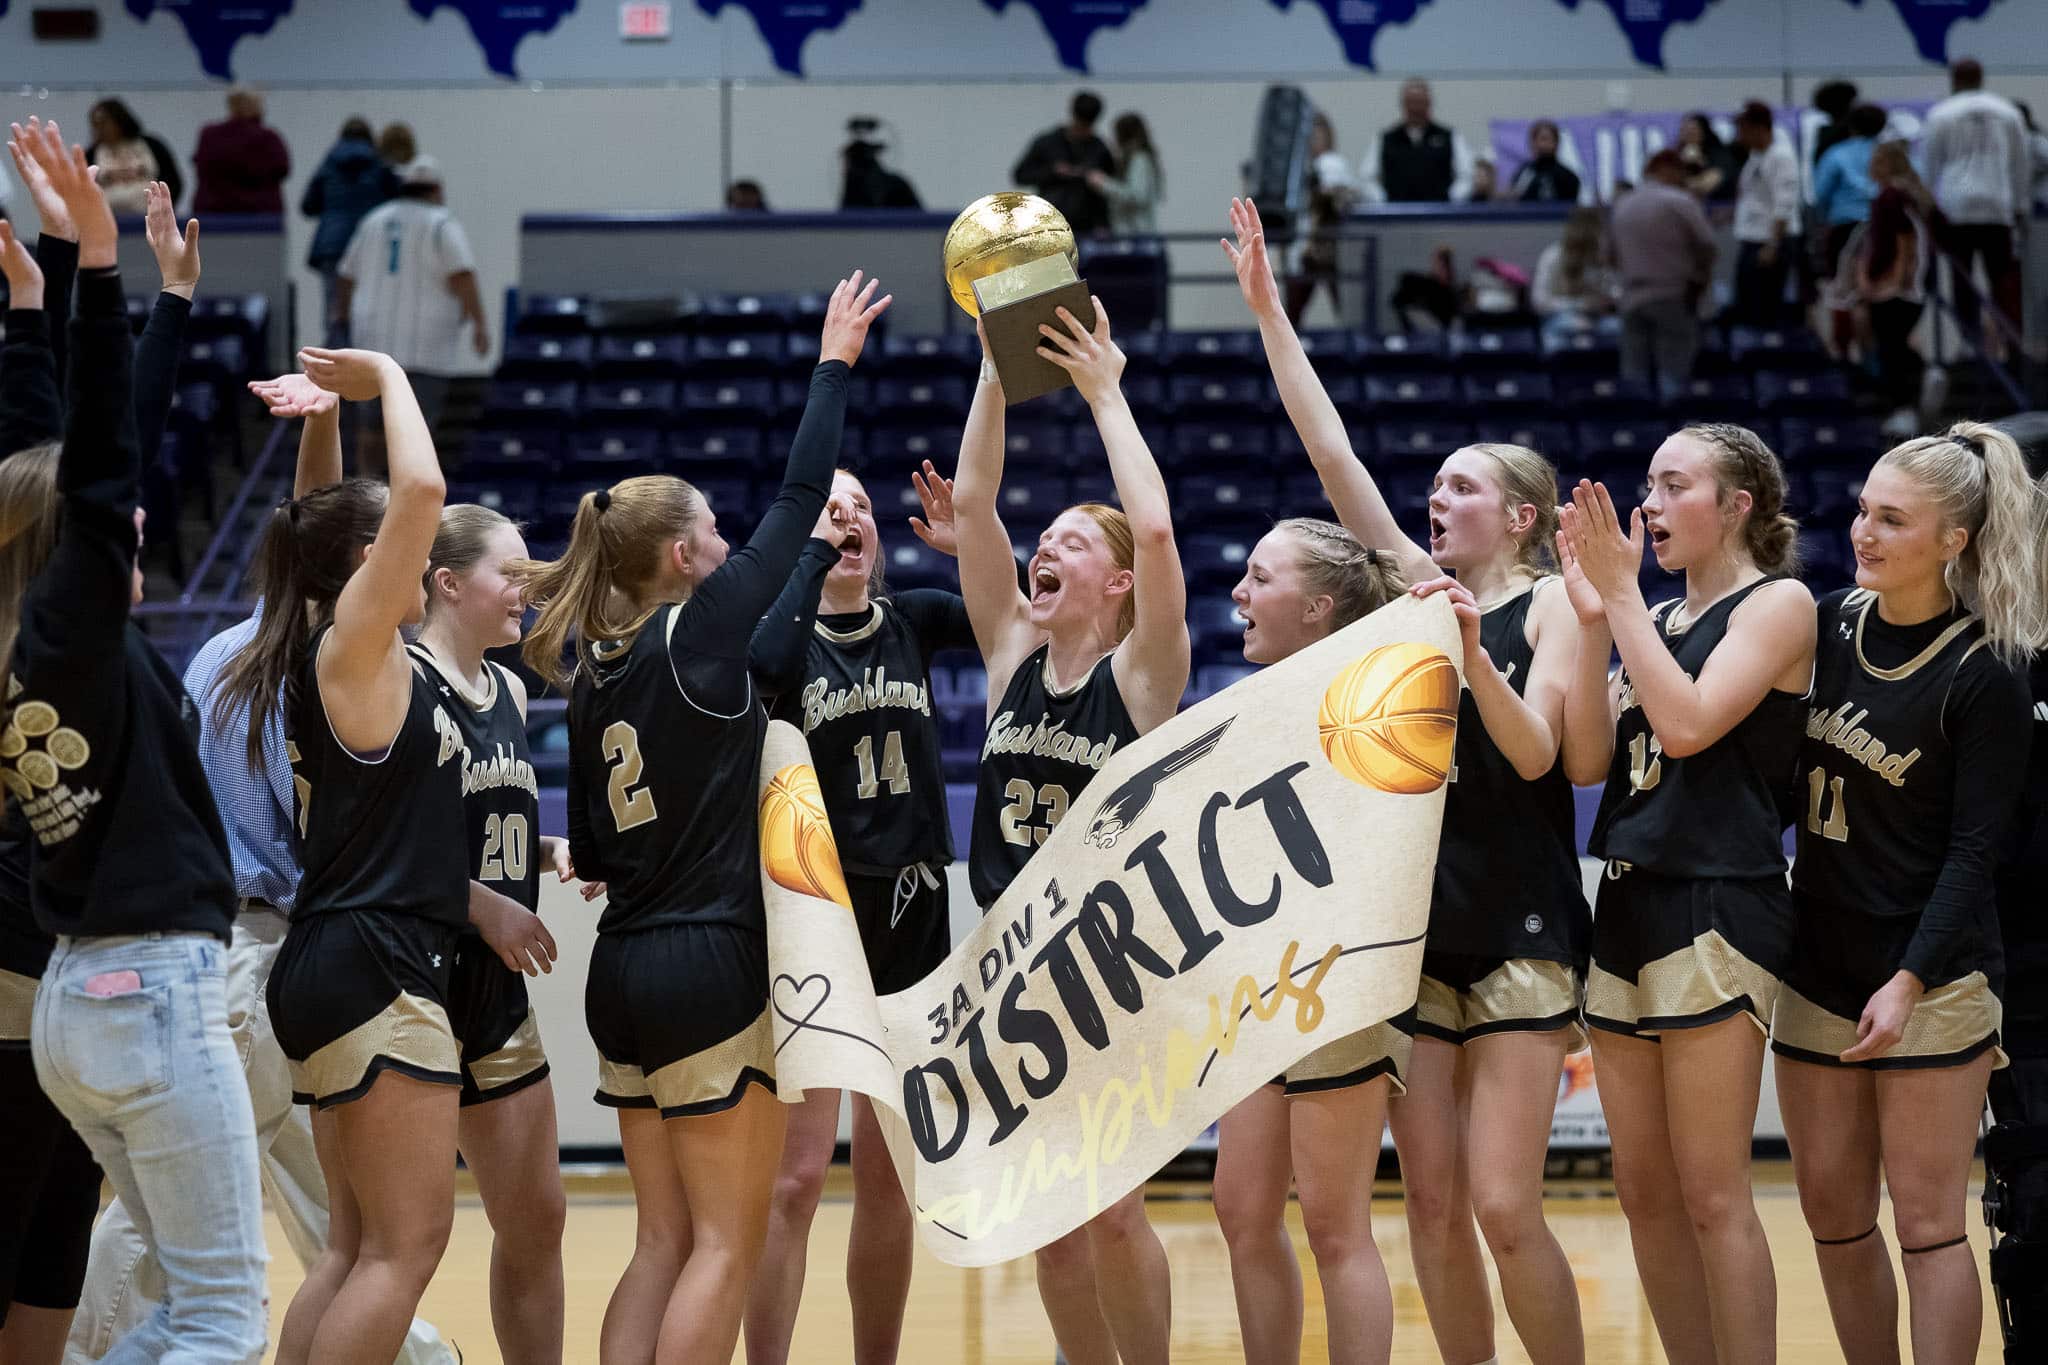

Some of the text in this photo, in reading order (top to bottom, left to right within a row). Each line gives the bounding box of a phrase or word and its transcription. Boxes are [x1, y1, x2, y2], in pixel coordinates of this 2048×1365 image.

[602, 720, 657, 832] 2
[853, 731, 911, 799] 14
[1806, 701, 1922, 786] shland
[1000, 778, 1069, 847] 23
[1808, 766, 1849, 843] 11
[479, 813, 528, 881] 20
[903, 761, 1334, 1163] DISTRICT
[928, 877, 1069, 1044] 3A DIV 1
